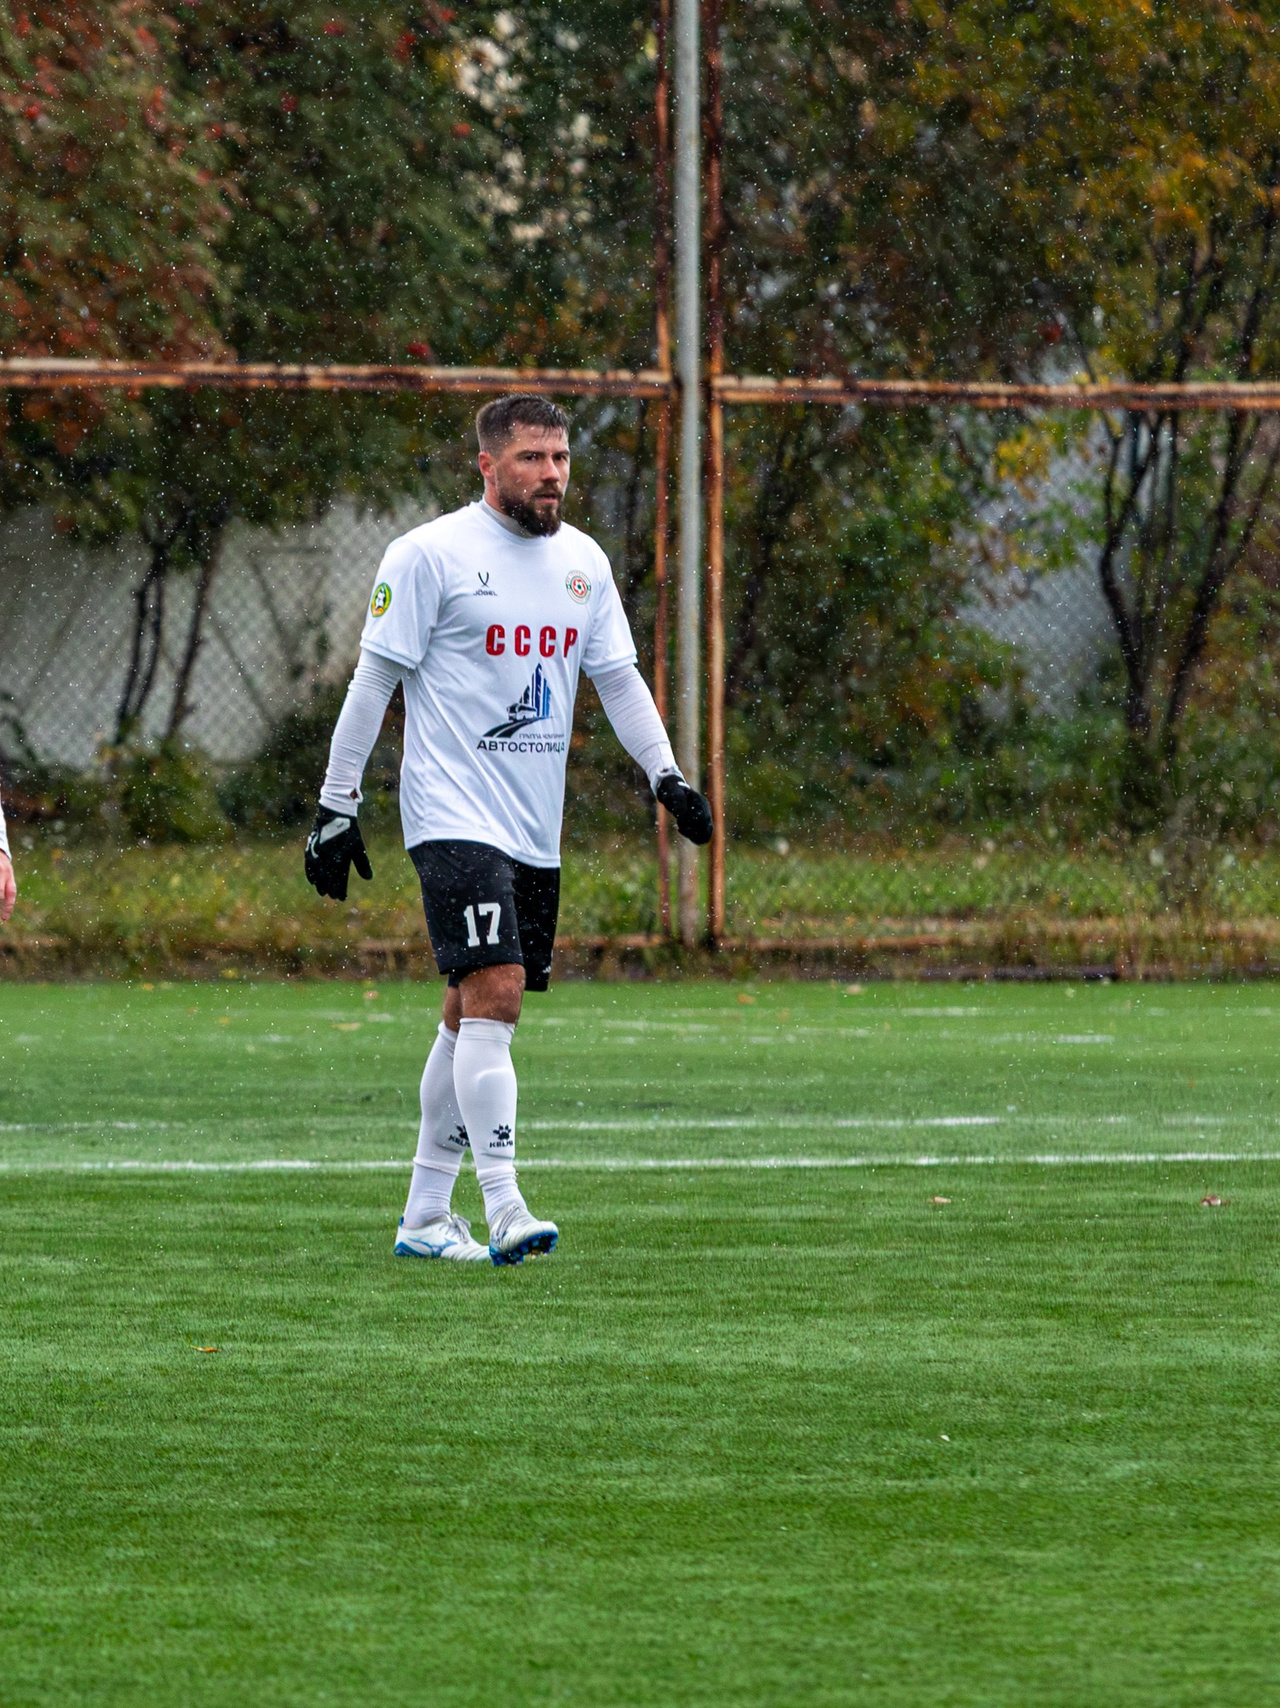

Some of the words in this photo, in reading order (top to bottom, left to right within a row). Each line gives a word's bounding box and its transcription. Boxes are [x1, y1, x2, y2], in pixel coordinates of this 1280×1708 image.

[485, 624, 578, 658] СССР
[476, 740, 565, 754] АВТОСТОЛИЦА
[463, 902, 502, 947] 17
